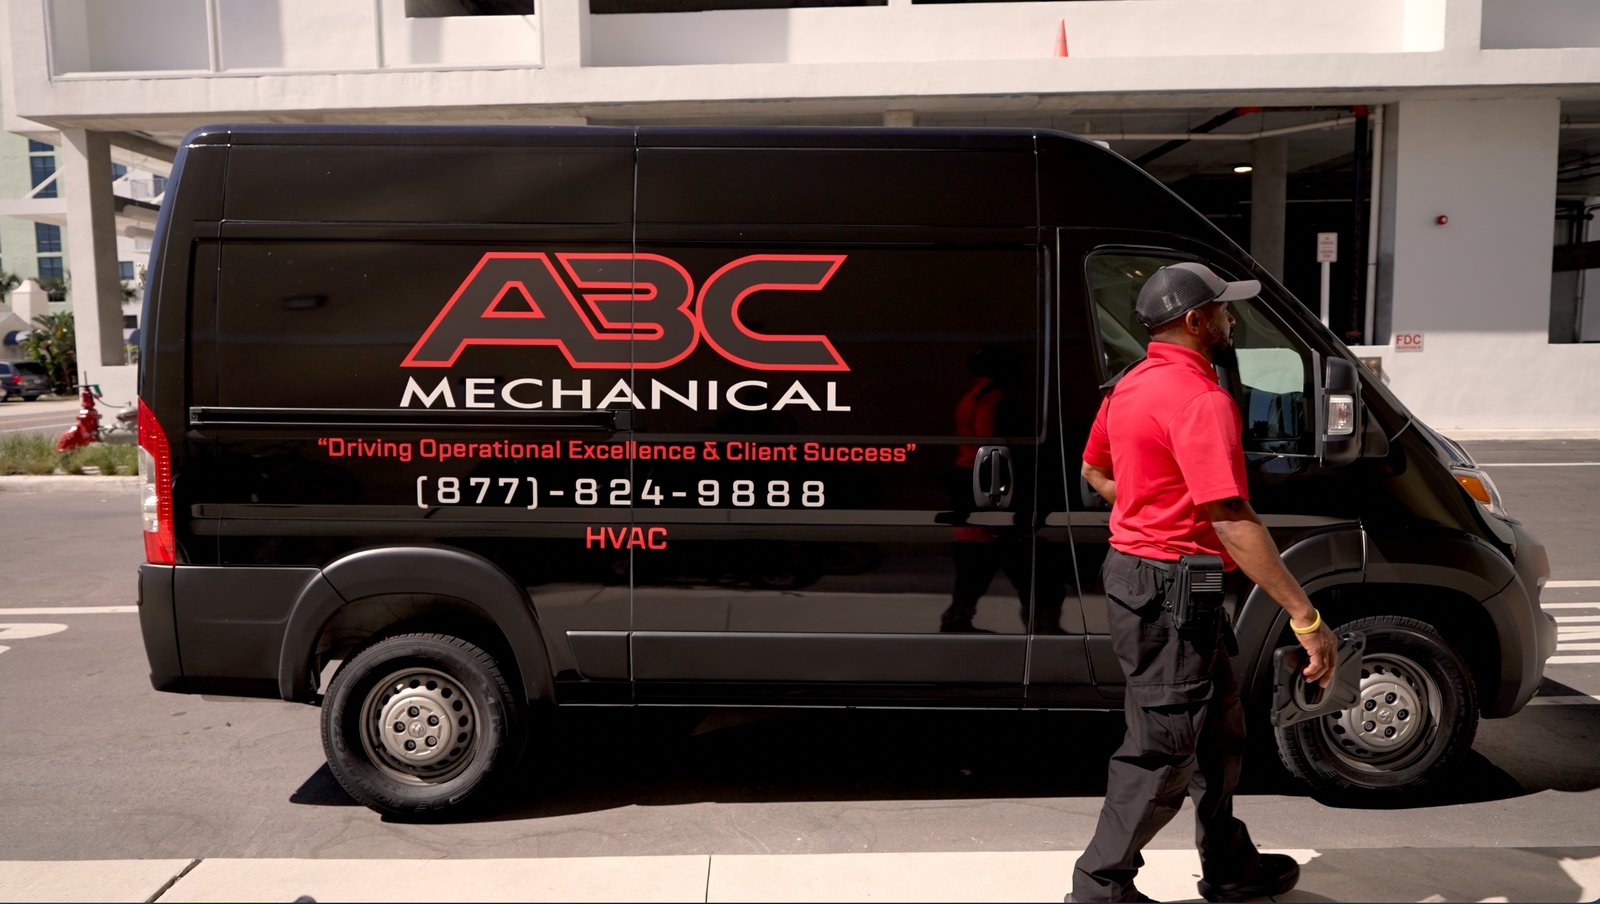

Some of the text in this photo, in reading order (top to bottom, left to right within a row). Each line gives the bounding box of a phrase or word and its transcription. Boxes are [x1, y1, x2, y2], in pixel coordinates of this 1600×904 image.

[400, 252, 851, 371] ABC
[1396, 335, 1421, 345] FDC
[400, 376, 851, 412] MECHANICAL
[317, 437, 917, 463] “Driving Operational Excellence & Client Success”
[416, 475, 825, 510] (877)-824-9888
[585, 527, 667, 550] HVAC
